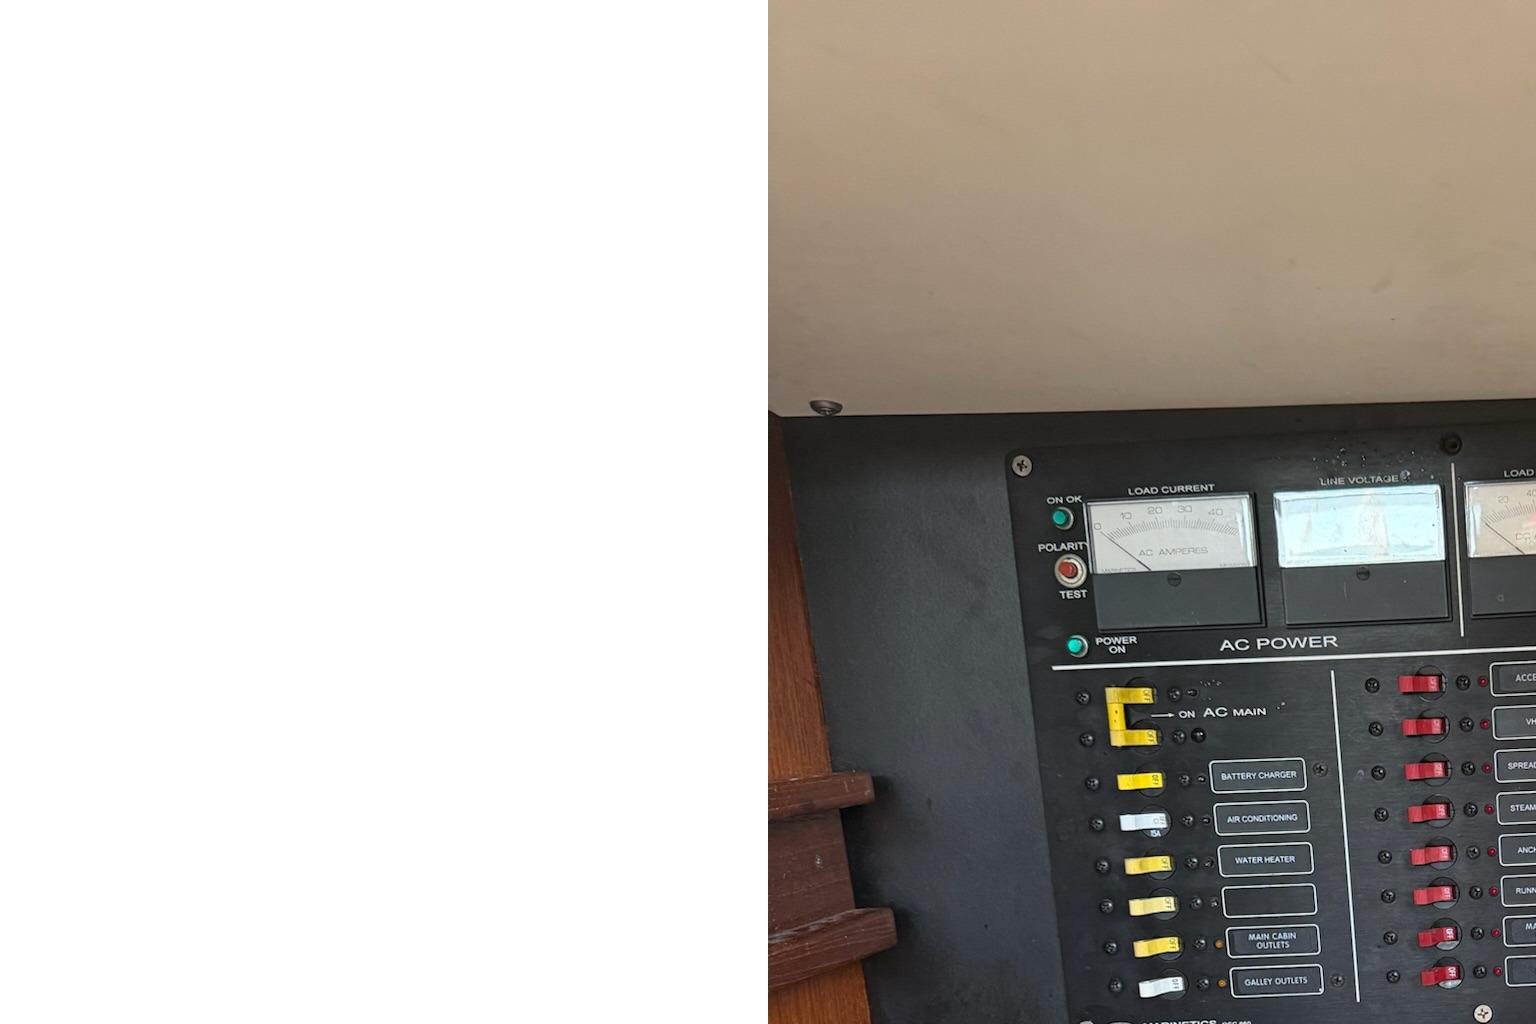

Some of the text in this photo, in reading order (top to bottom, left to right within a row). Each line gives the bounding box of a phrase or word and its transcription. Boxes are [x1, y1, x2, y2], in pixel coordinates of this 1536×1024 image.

[1504, 468, 1534, 478] LOAD
[1319, 474, 1400, 486] LINE VOLTAGE
[1128, 483, 1215, 496] LOAD CURRENT
[1046, 495, 1082, 505] ON OK
[1147, 506, 1163, 515] 20
[1177, 504, 1192, 513] 30
[1208, 508, 1223, 517] 40
[1120, 511, 1132, 521] 10
[1138, 546, 1209, 557] AC AMPERES
[1059, 590, 1088, 599] TEST
[1095, 635, 1138, 646] POWER
[1219, 635, 1339, 651] AC POWER
[1109, 645, 1126, 654] ON
[1178, 706, 1267, 719] ON AC MAIN
[1221, 770, 1297, 781] BATTERY CHARGER
[1227, 813, 1298, 823] AIR CONDITIONING
[1235, 855, 1296, 864] WATER HEATER
[1248, 931, 1297, 941] MAIN CABIN
[1256, 940, 1290, 950] OUTLETS
[1244, 975, 1308, 986] GALLEY OUTLETS
